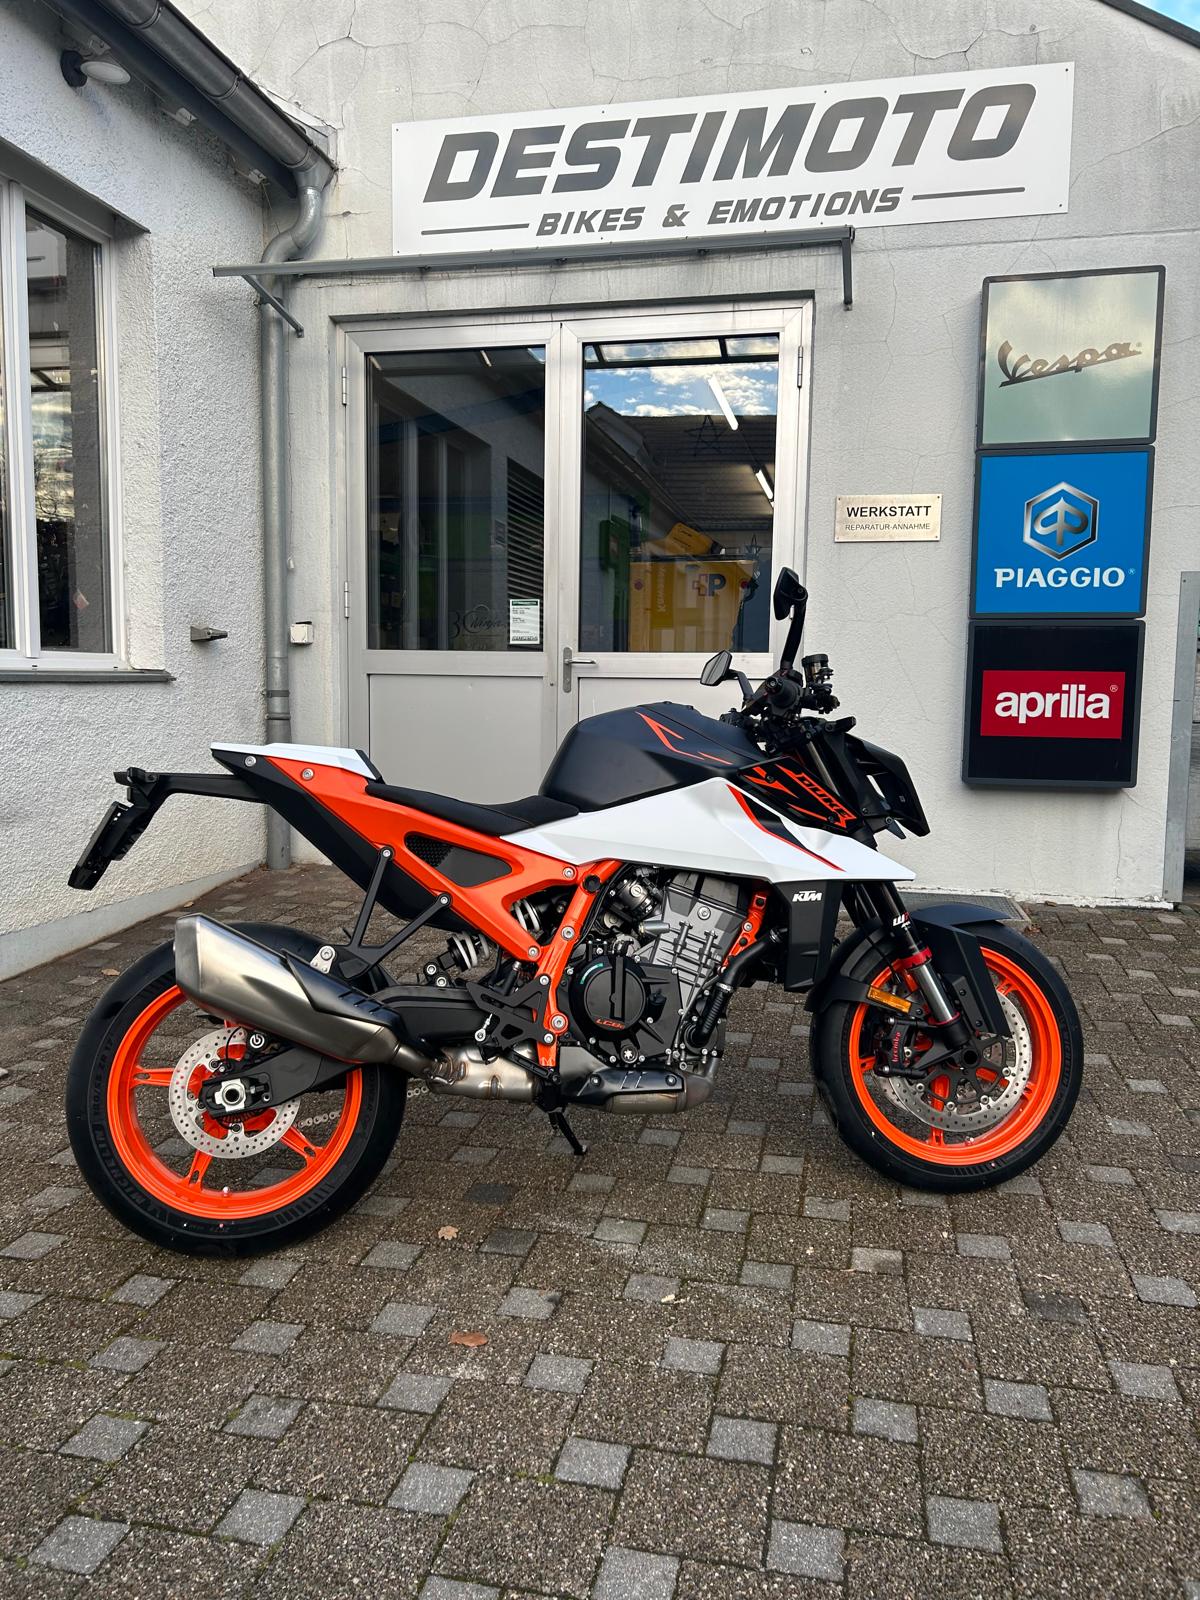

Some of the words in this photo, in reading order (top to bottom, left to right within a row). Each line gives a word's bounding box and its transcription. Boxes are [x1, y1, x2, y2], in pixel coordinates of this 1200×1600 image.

[422, 83, 1037, 203] DESTIMOTO
[535, 207, 646, 237] BIKES
[662, 203, 690, 228] &
[707, 186, 904, 226] EMOTIONS
[998, 340, 1141, 388] Vespa
[845, 523, 931, 531] REPARATUR-ANNAHME
[846, 505, 932, 518] WERKSTATT
[993, 567, 1126, 589] PIAGGIO
[994, 683, 1112, 725] aprilia
[792, 890, 823, 903] KTM
